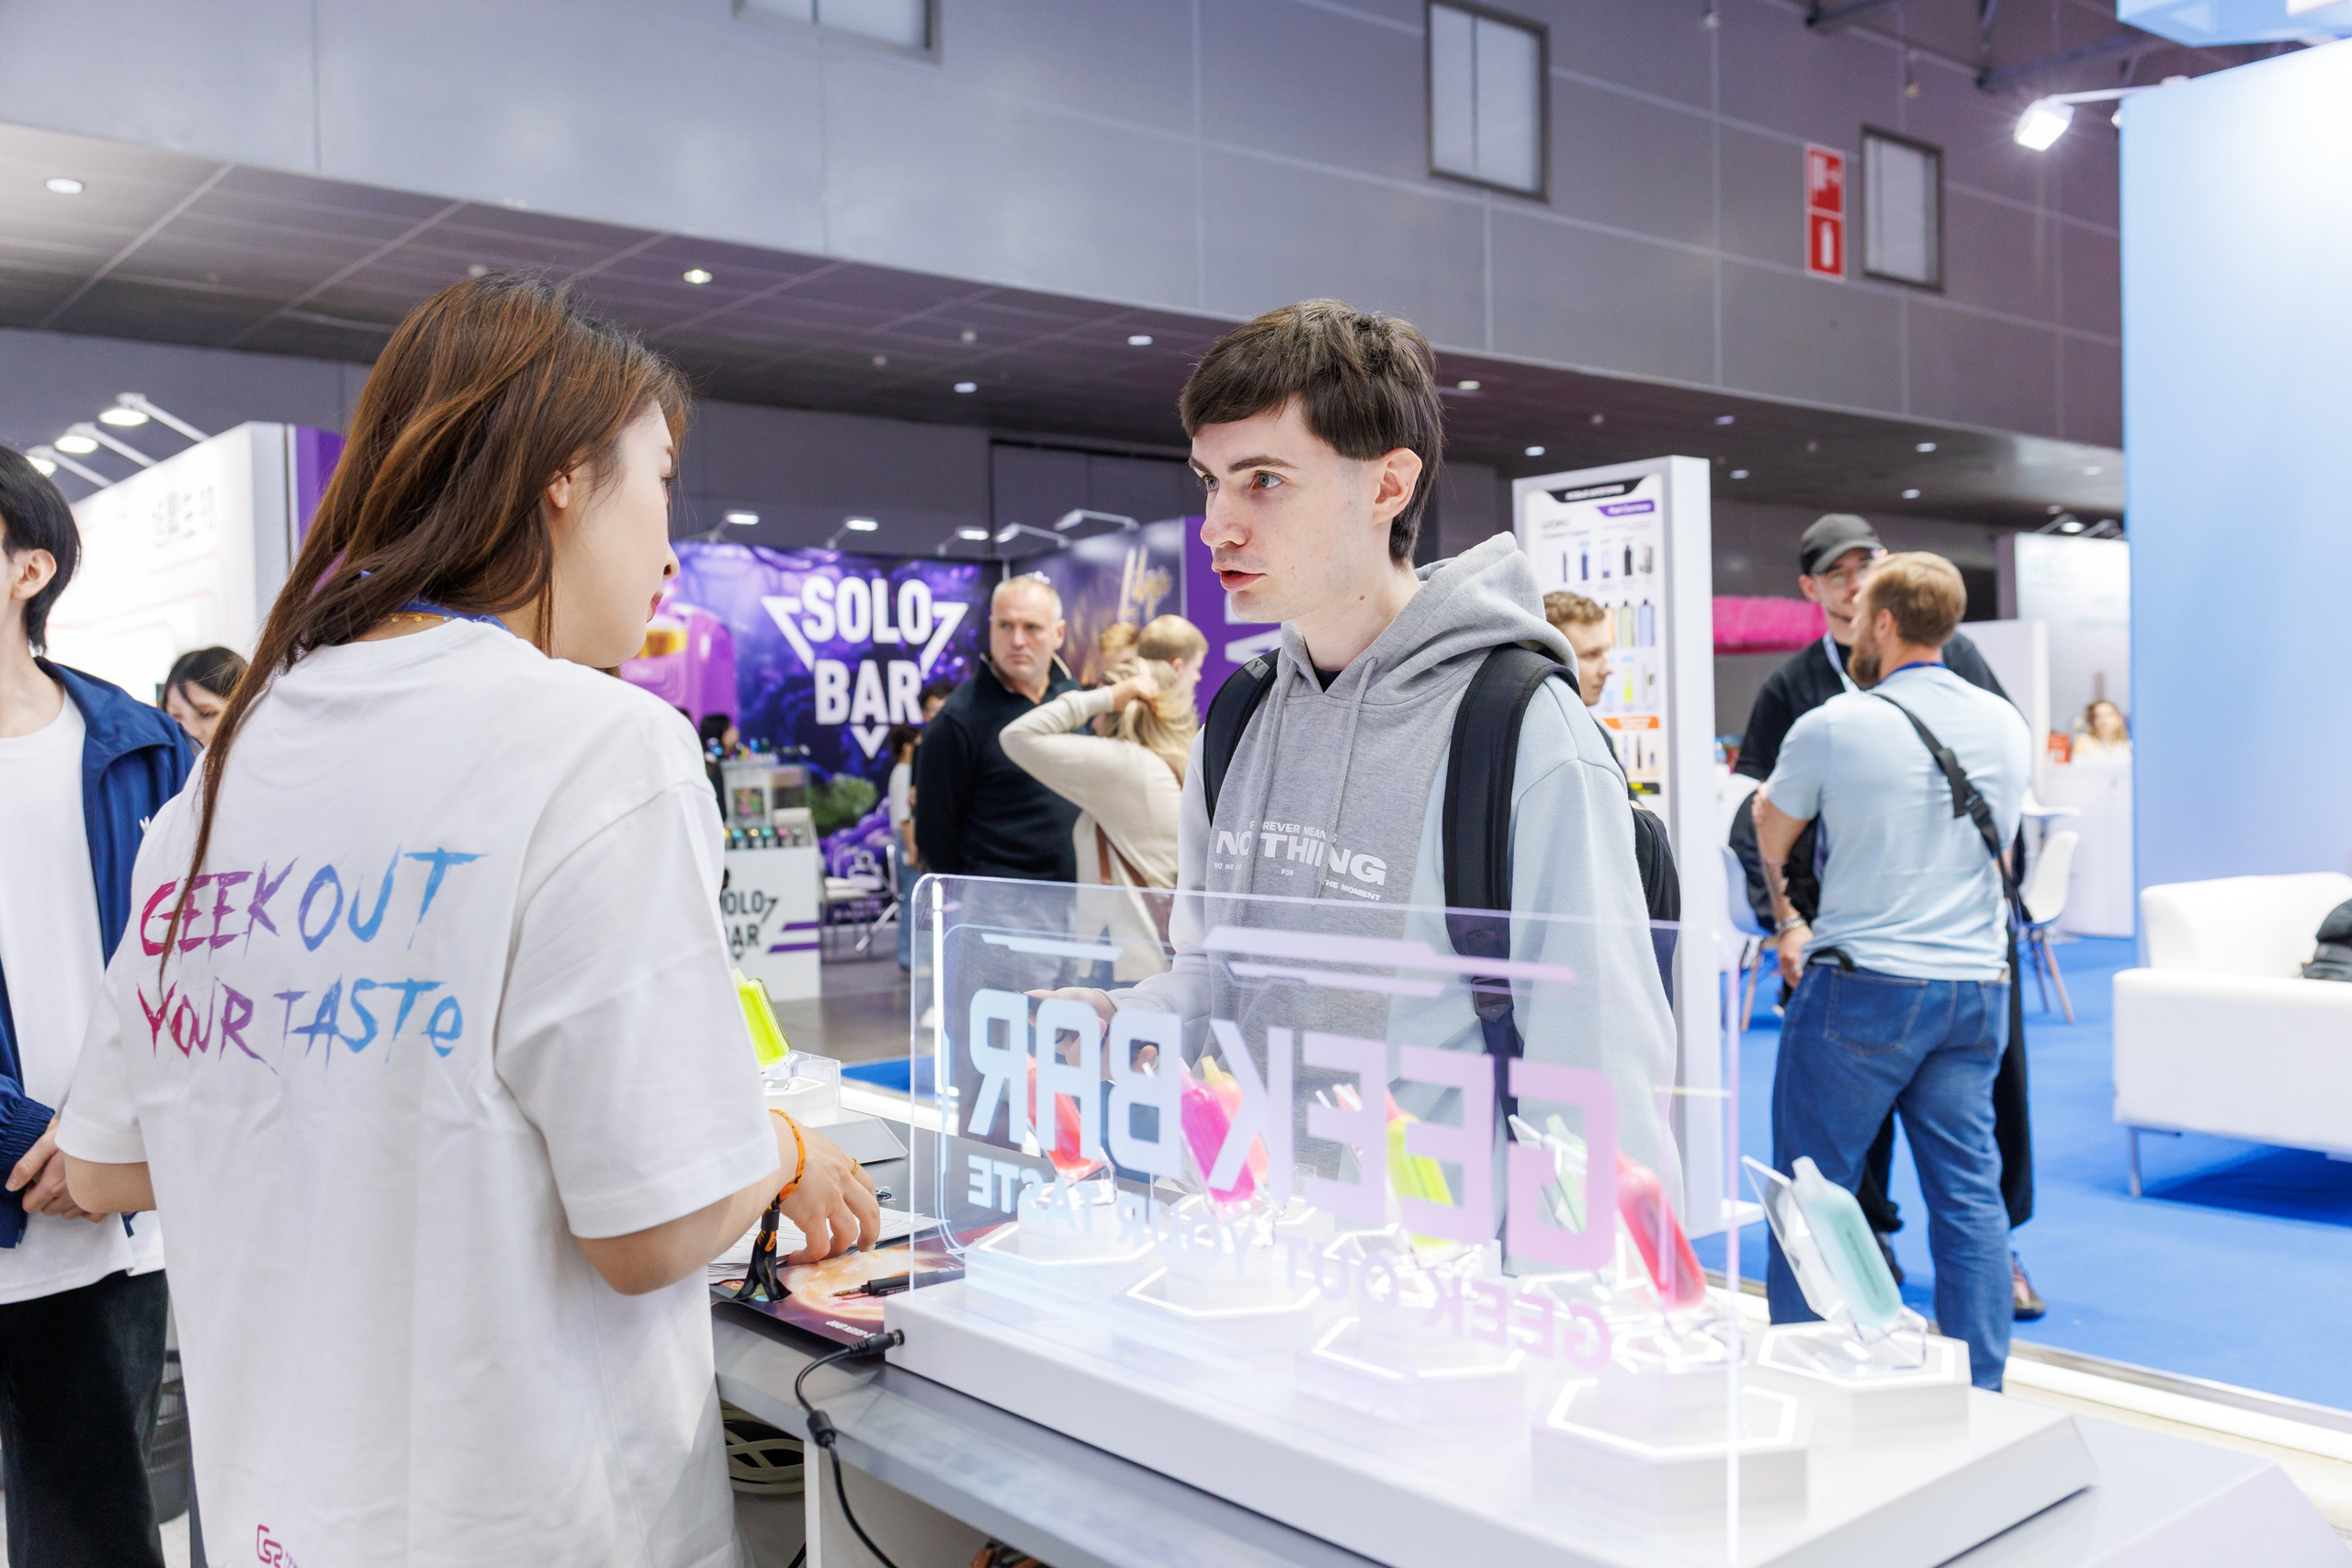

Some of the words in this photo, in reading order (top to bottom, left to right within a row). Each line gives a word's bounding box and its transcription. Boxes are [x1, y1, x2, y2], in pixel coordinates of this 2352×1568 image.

[801, 576, 933, 645] SOLO
[815, 660, 924, 725] BAR
[1250, 820, 1301, 834] FREVER
[1216, 830, 1387, 886] NOTHING
[1281, 868, 1295, 876] FOR
[1340, 884, 1382, 901] MOMENT
[140, 856, 300, 963] GEEK
[298, 843, 489, 952] OUT
[720, 889, 763, 915] OLO
[725, 923, 760, 948] AR
[136, 976, 278, 1075] YOUR
